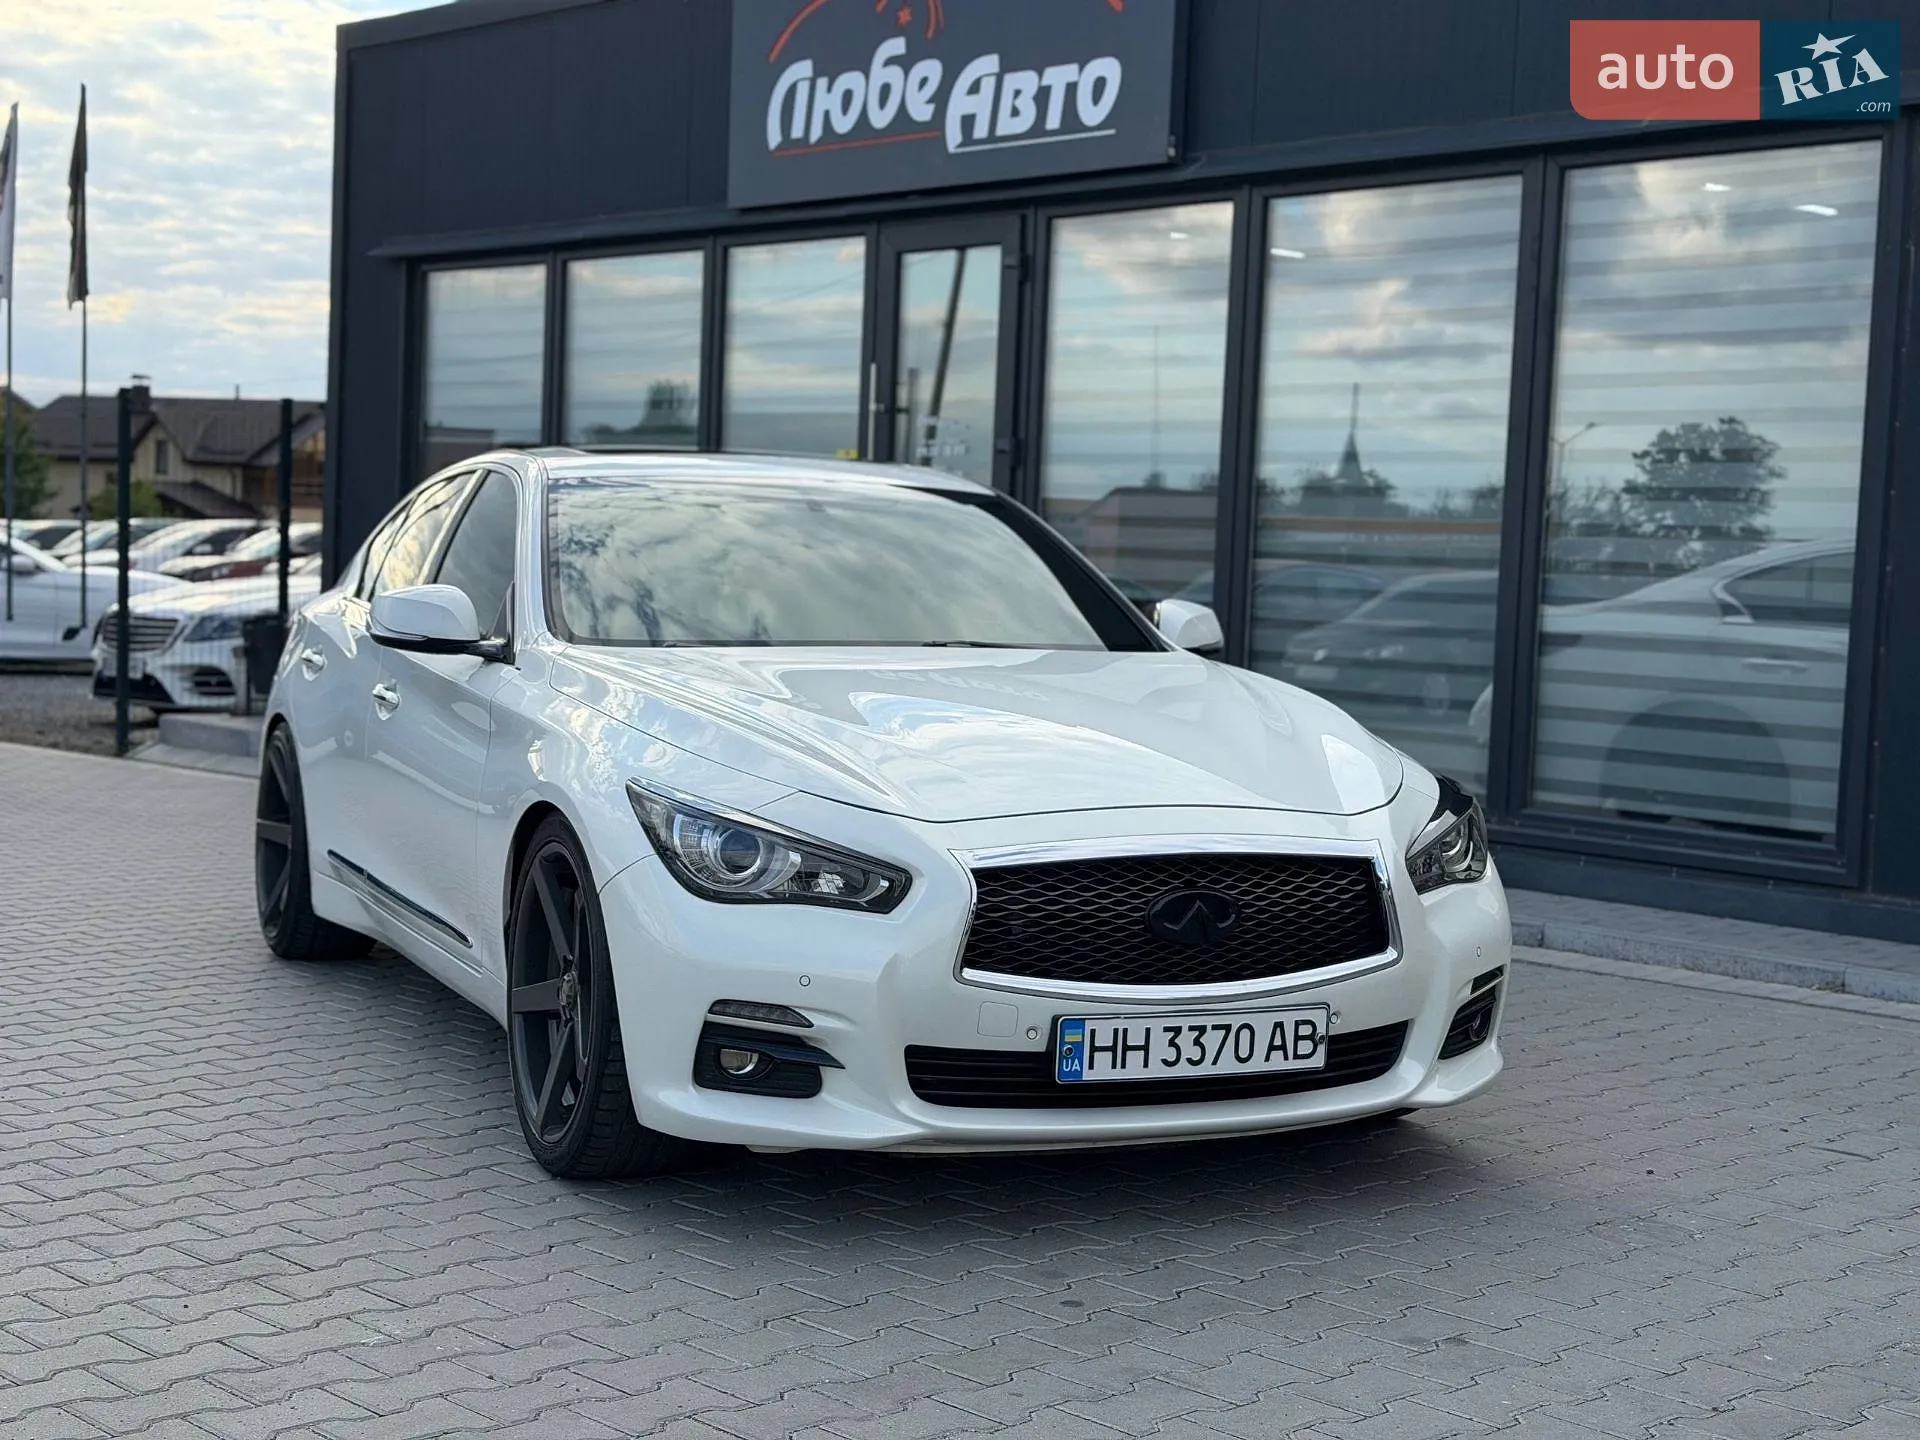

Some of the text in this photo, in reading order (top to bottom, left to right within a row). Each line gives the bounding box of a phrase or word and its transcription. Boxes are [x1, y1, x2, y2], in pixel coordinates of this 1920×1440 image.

[766, 36, 1123, 154] Любе Авто
[1063, 1060, 1081, 1073] UA
[1087, 1019, 1319, 1071] HH 3370 AB
